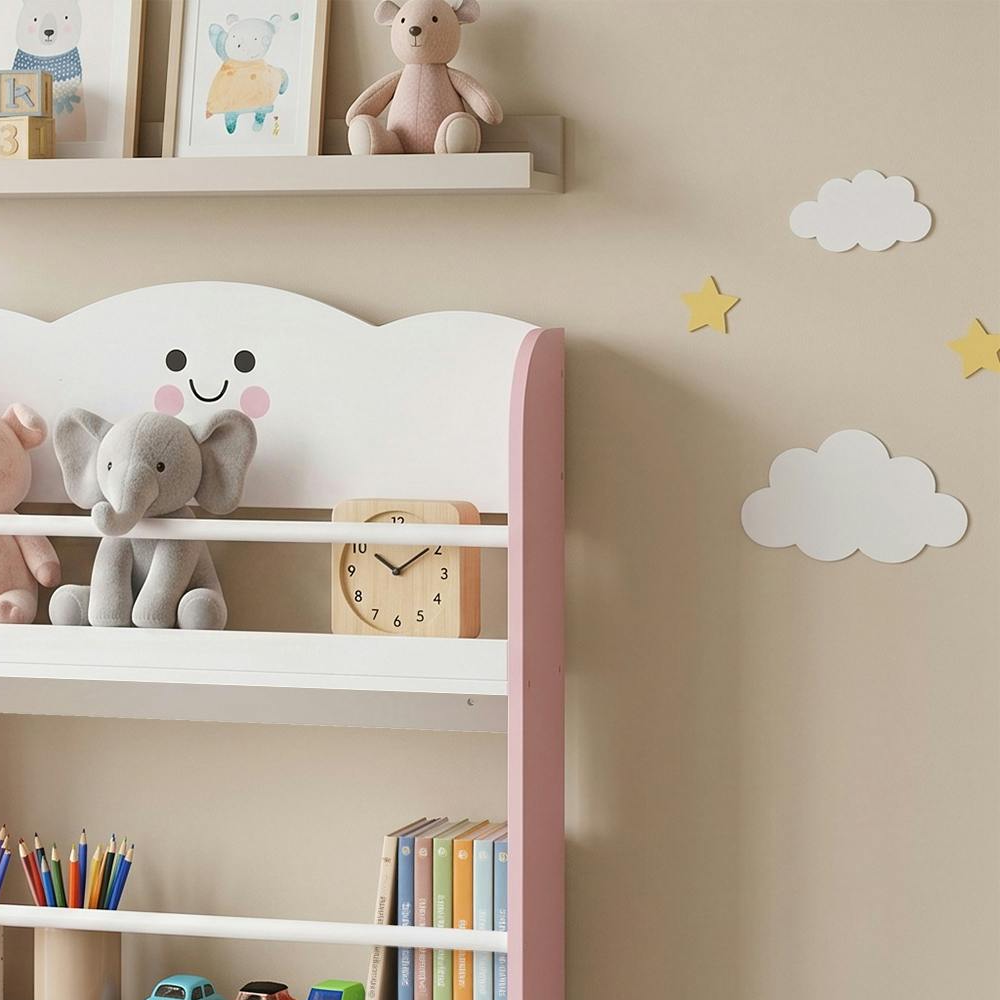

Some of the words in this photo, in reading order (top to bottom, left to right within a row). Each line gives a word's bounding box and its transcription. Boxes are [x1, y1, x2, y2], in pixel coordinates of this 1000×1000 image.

[352, 543, 367, 554] 10
[347, 564, 356, 577] 9
[440, 567, 449, 580] 3
[354, 589, 363, 602] 8
[433, 592, 442, 605] 4
[371, 608, 379, 620] 7
[416, 609, 425, 622] 5
[393, 615, 401, 628] 6
